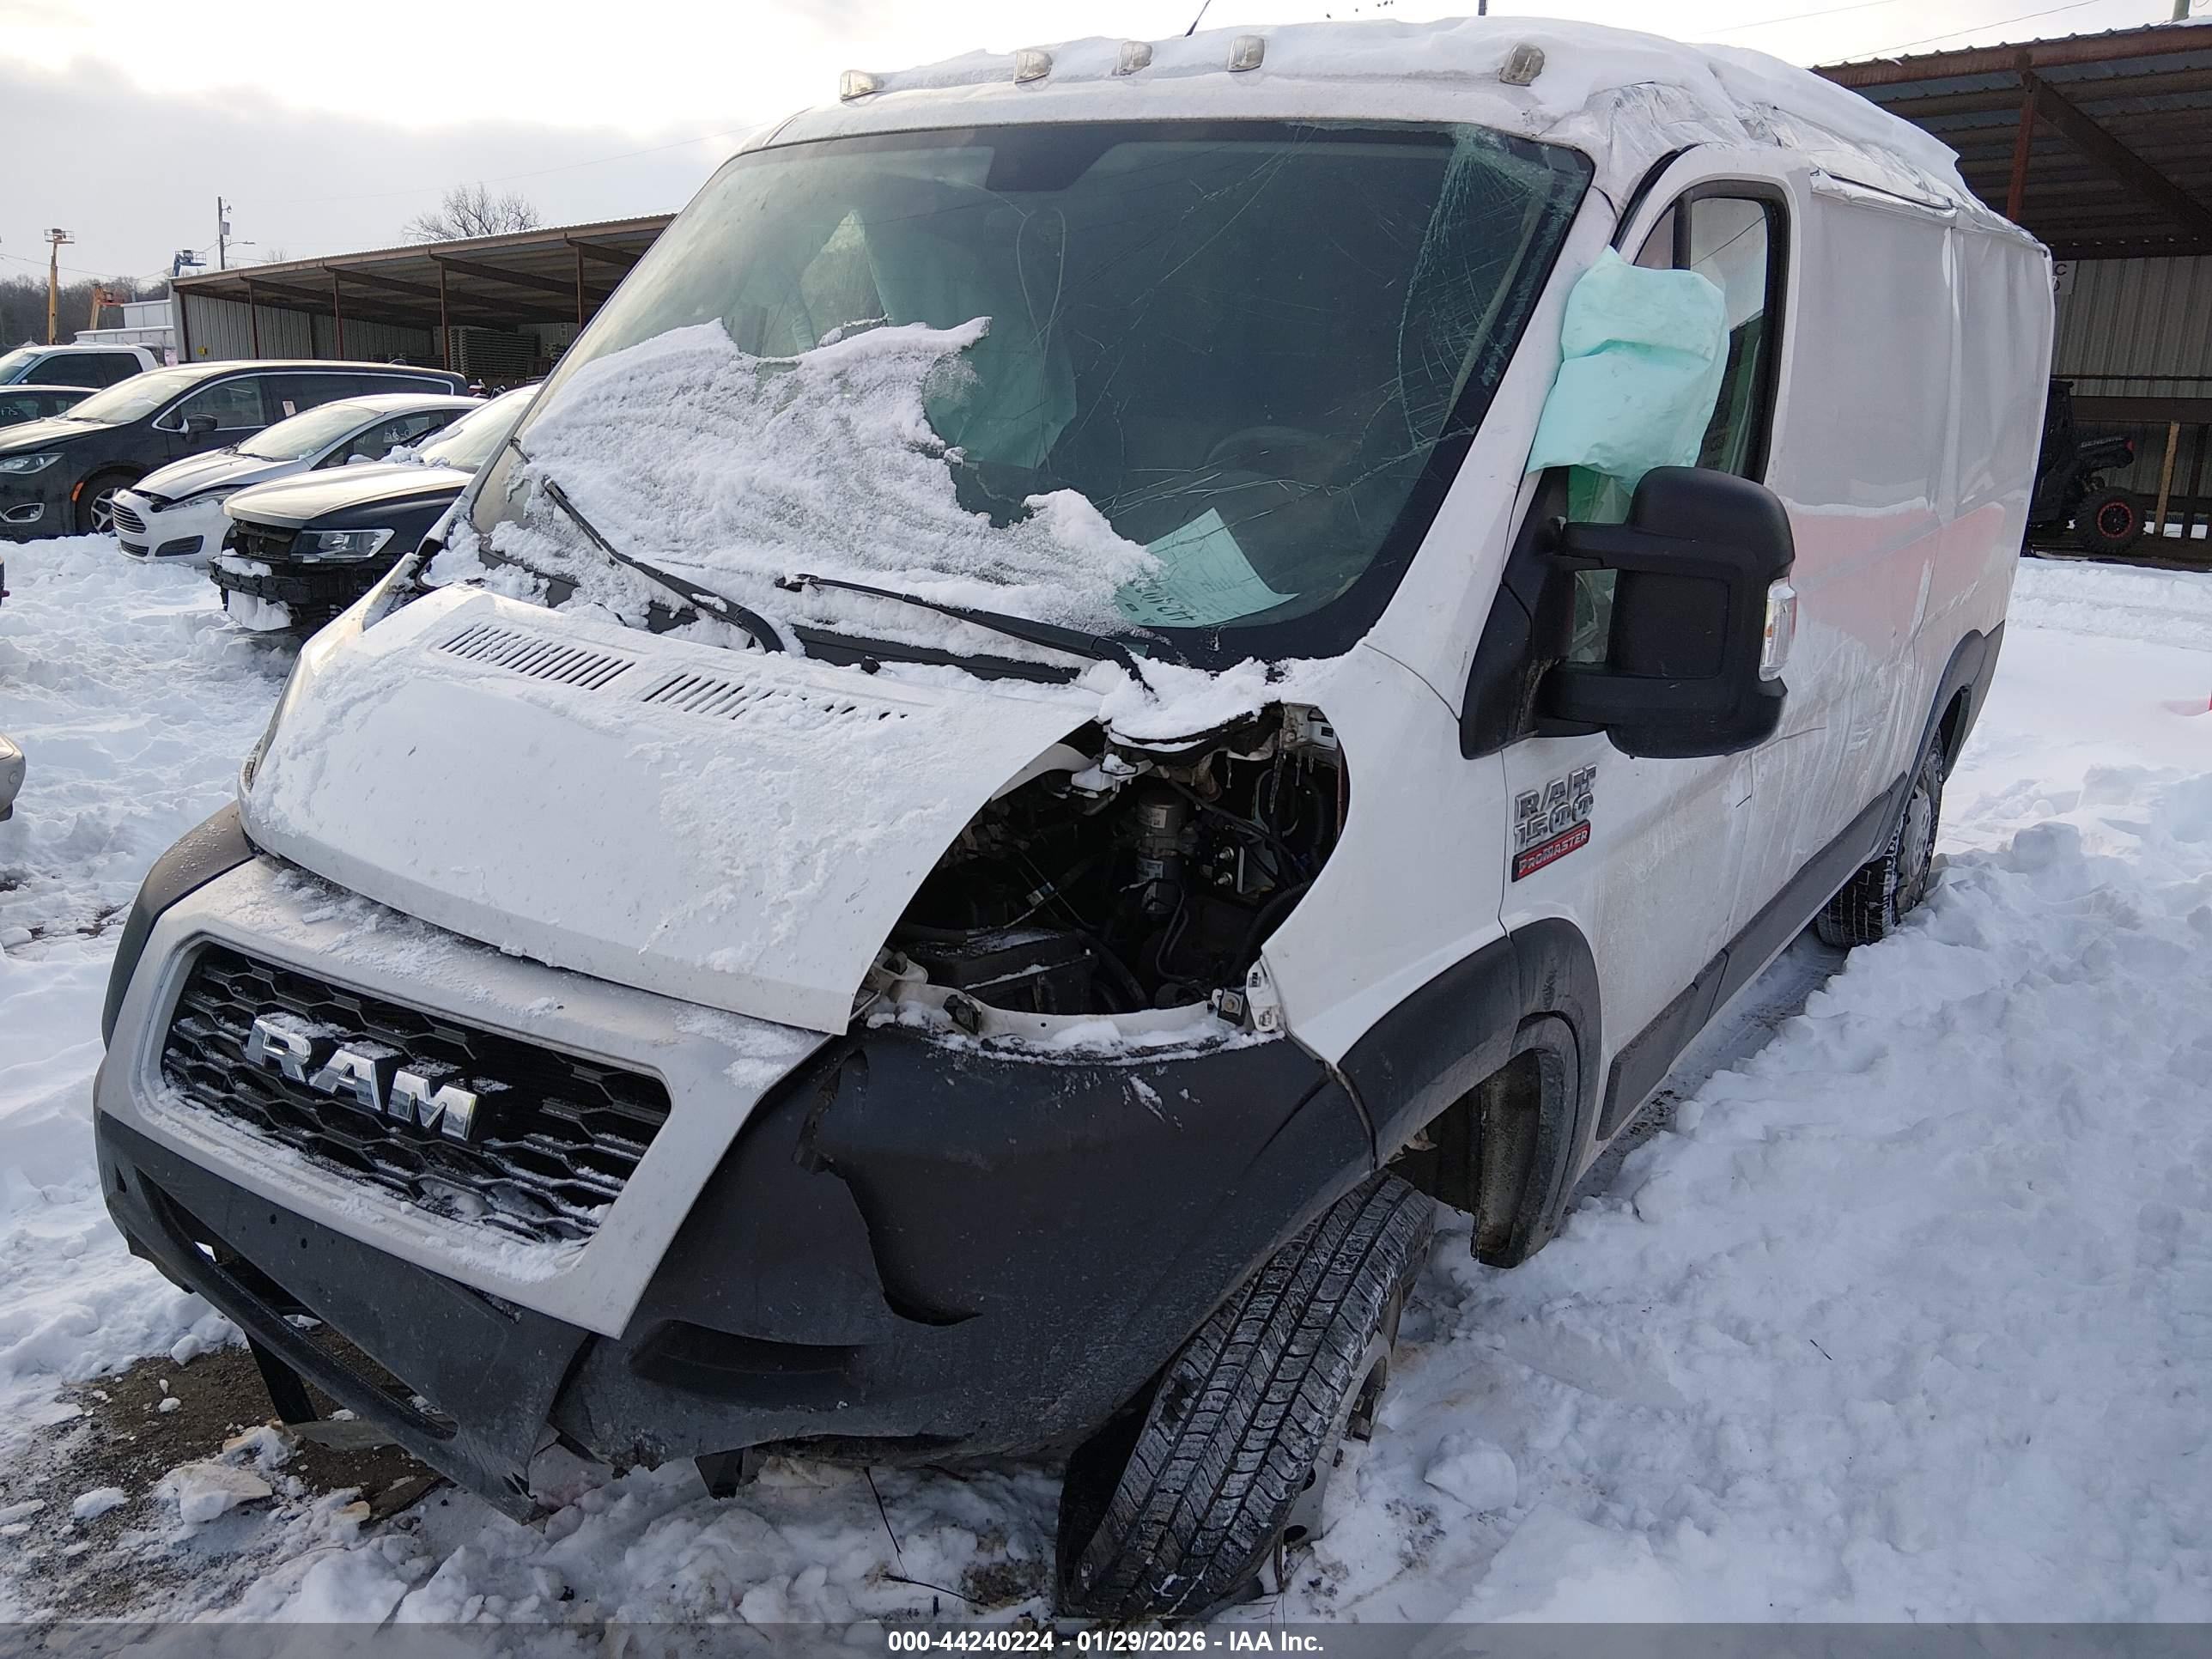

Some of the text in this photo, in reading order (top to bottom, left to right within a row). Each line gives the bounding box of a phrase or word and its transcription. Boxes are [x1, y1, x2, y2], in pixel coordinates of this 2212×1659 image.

[1514, 763, 1597, 823] RAM
[1514, 792, 1594, 852] 1500
[246, 1017, 477, 1141] RAM
